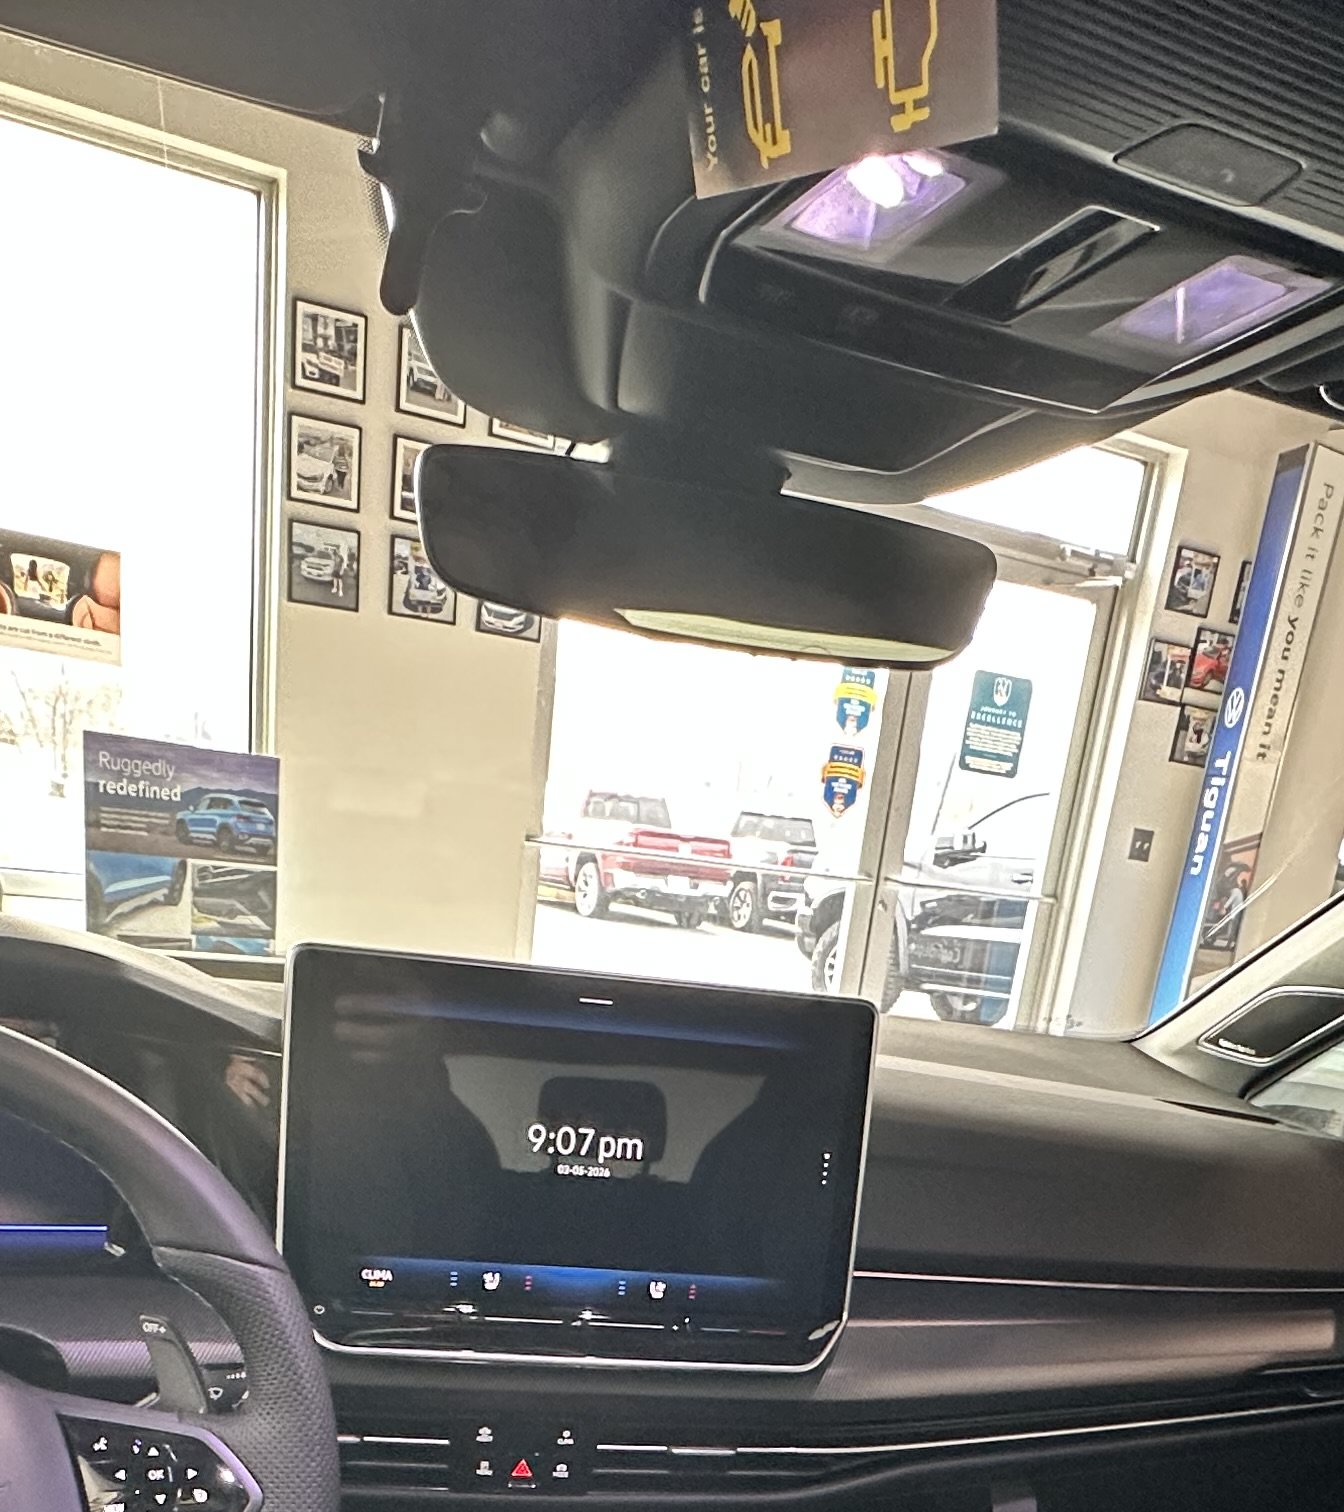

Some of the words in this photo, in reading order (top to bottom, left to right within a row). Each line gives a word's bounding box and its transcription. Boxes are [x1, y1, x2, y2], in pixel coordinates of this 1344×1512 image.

[696, 43, 710, 92] car
[704, 102, 718, 172] Your
[1310, 482, 1335, 538] Pack
[1304, 545, 1318, 560] it
[1295, 565, 1313, 608] like
[1281, 615, 1300, 661] you
[1261, 668, 1286, 736] mean
[98, 752, 176, 782] Ruggedly
[1255, 742, 1271, 761] it
[98, 780, 181, 802] redefined
[1190, 751, 1232, 876] Tiguan
[361, 1269, 393, 1281] CLIMA
[148, 1469, 165, 1480] OK
